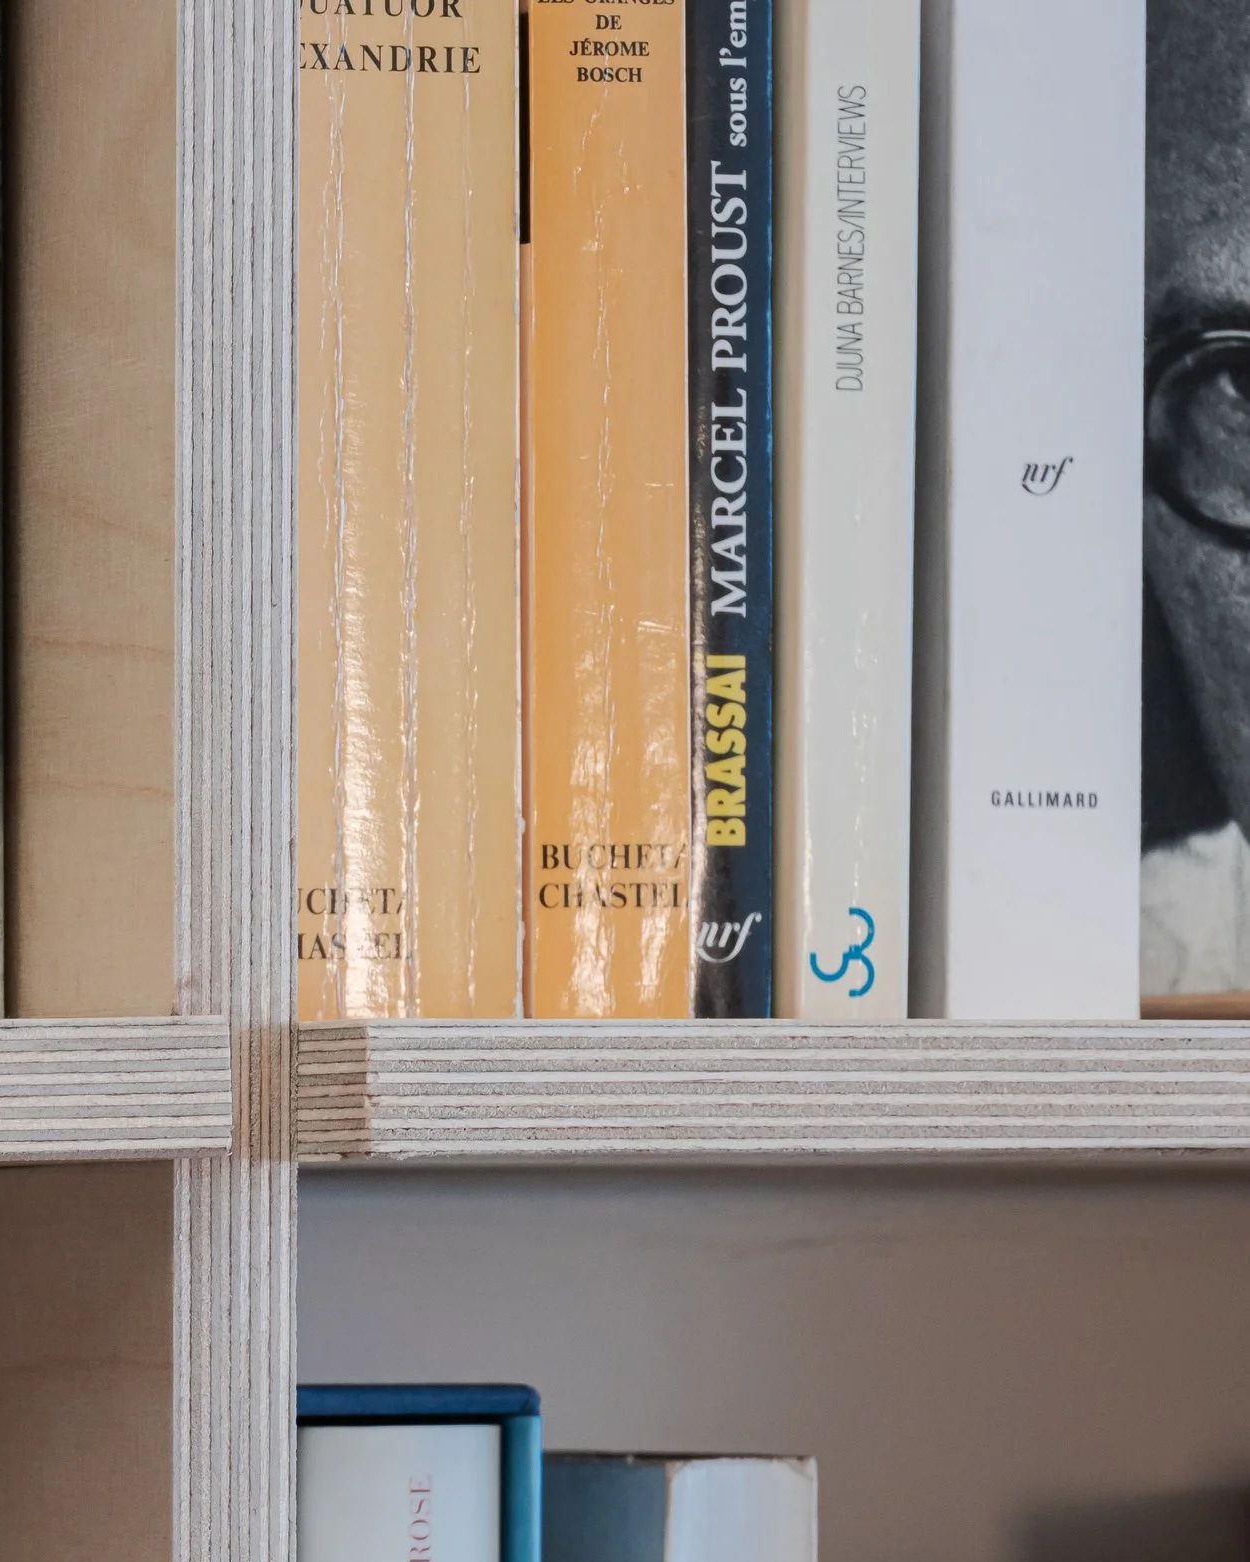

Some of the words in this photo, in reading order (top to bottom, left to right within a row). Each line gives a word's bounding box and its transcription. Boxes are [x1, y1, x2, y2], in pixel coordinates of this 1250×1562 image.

[595, 14, 622, 30] DE
[569, 38, 650, 57] JÉROME
[576, 67, 643, 83] BOSCH
[729, 77, 748, 148] sous
[710, 160, 748, 373] PROUST
[835, 322, 864, 392] DJUNA
[1021, 456, 1073, 496] nrf
[710, 388, 748, 618] MARCEL
[990, 790, 1099, 809] GALLIMARD
[696, 911, 762, 963] nrf
